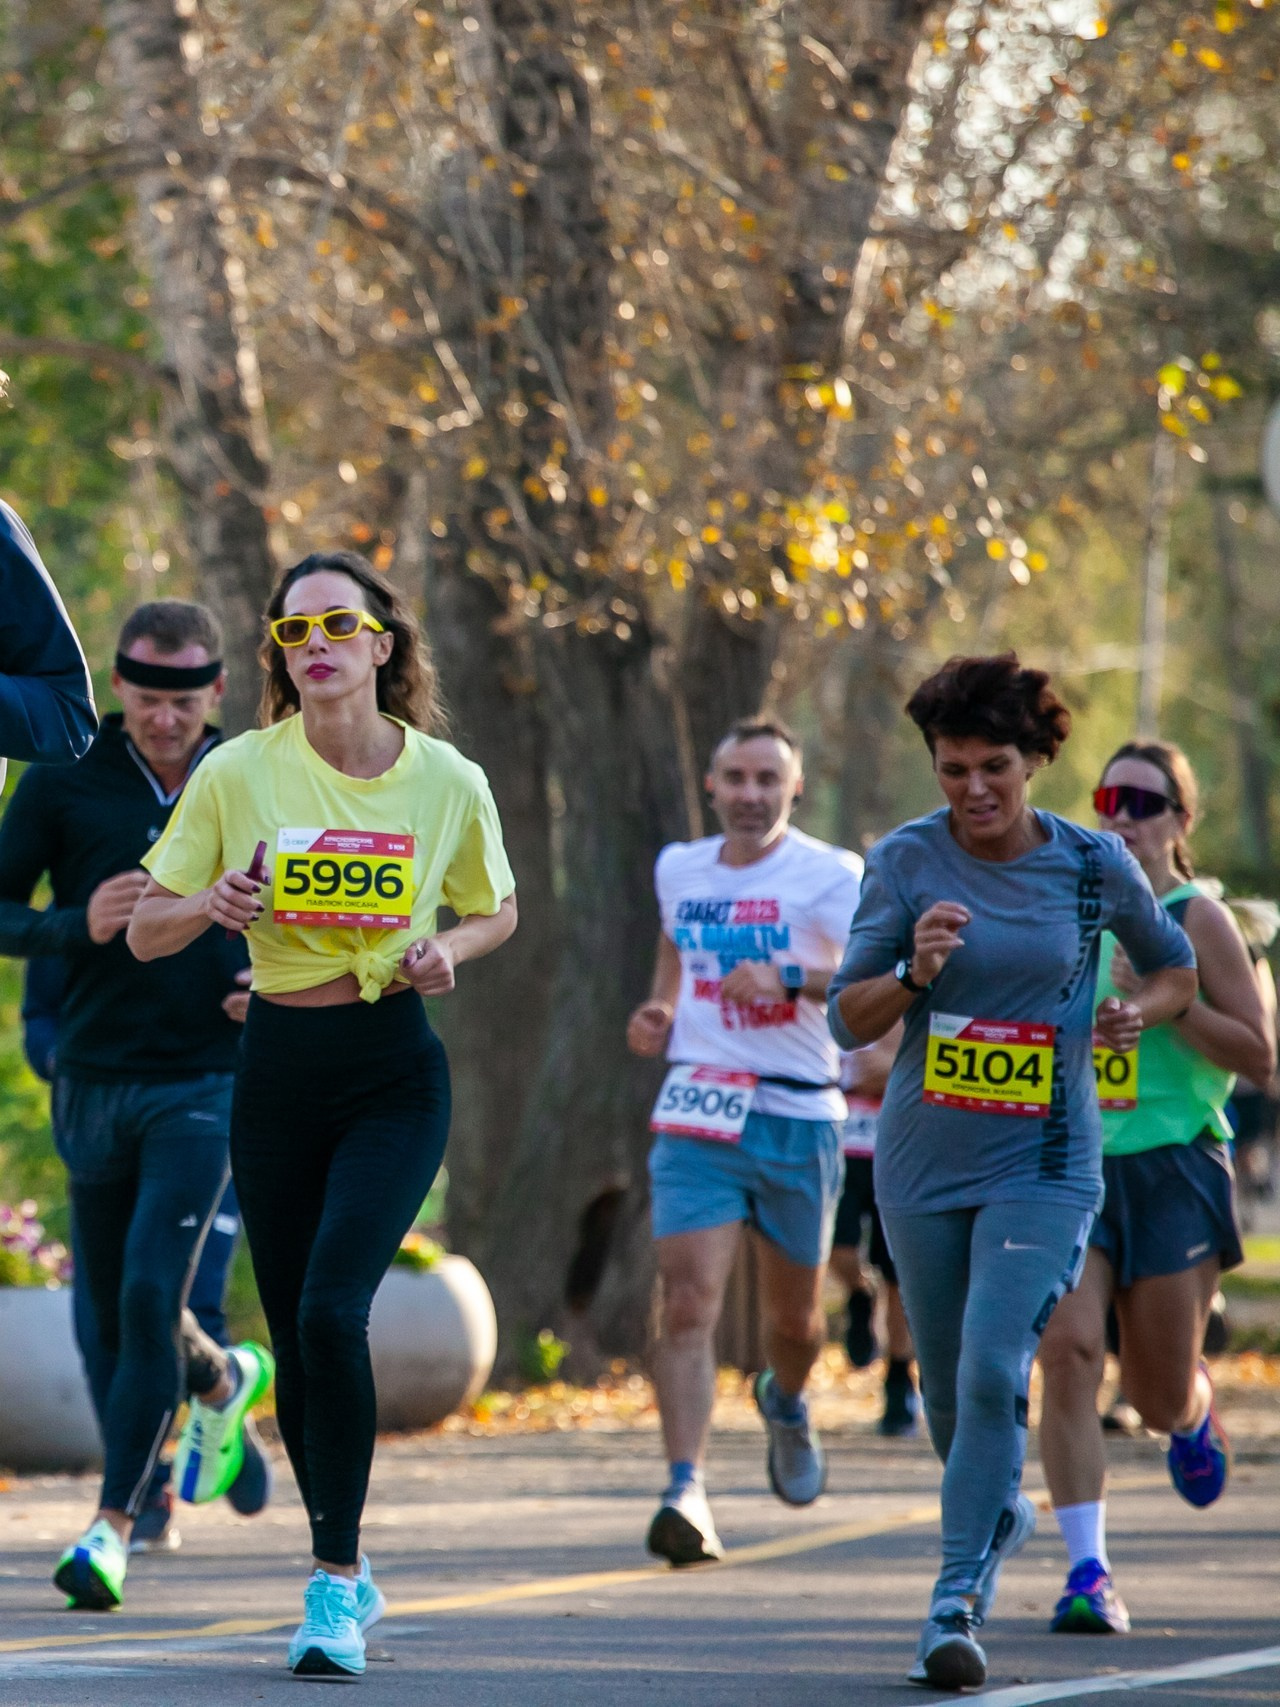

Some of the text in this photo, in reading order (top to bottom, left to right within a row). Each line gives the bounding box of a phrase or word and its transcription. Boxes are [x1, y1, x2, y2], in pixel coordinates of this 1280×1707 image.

[283, 858, 404, 900] 5996
[306, 899, 379, 909] ПАВЛЮК ОКСАНА
[934, 1042, 1044, 1088] 5104
[662, 1084, 743, 1119] 5906
